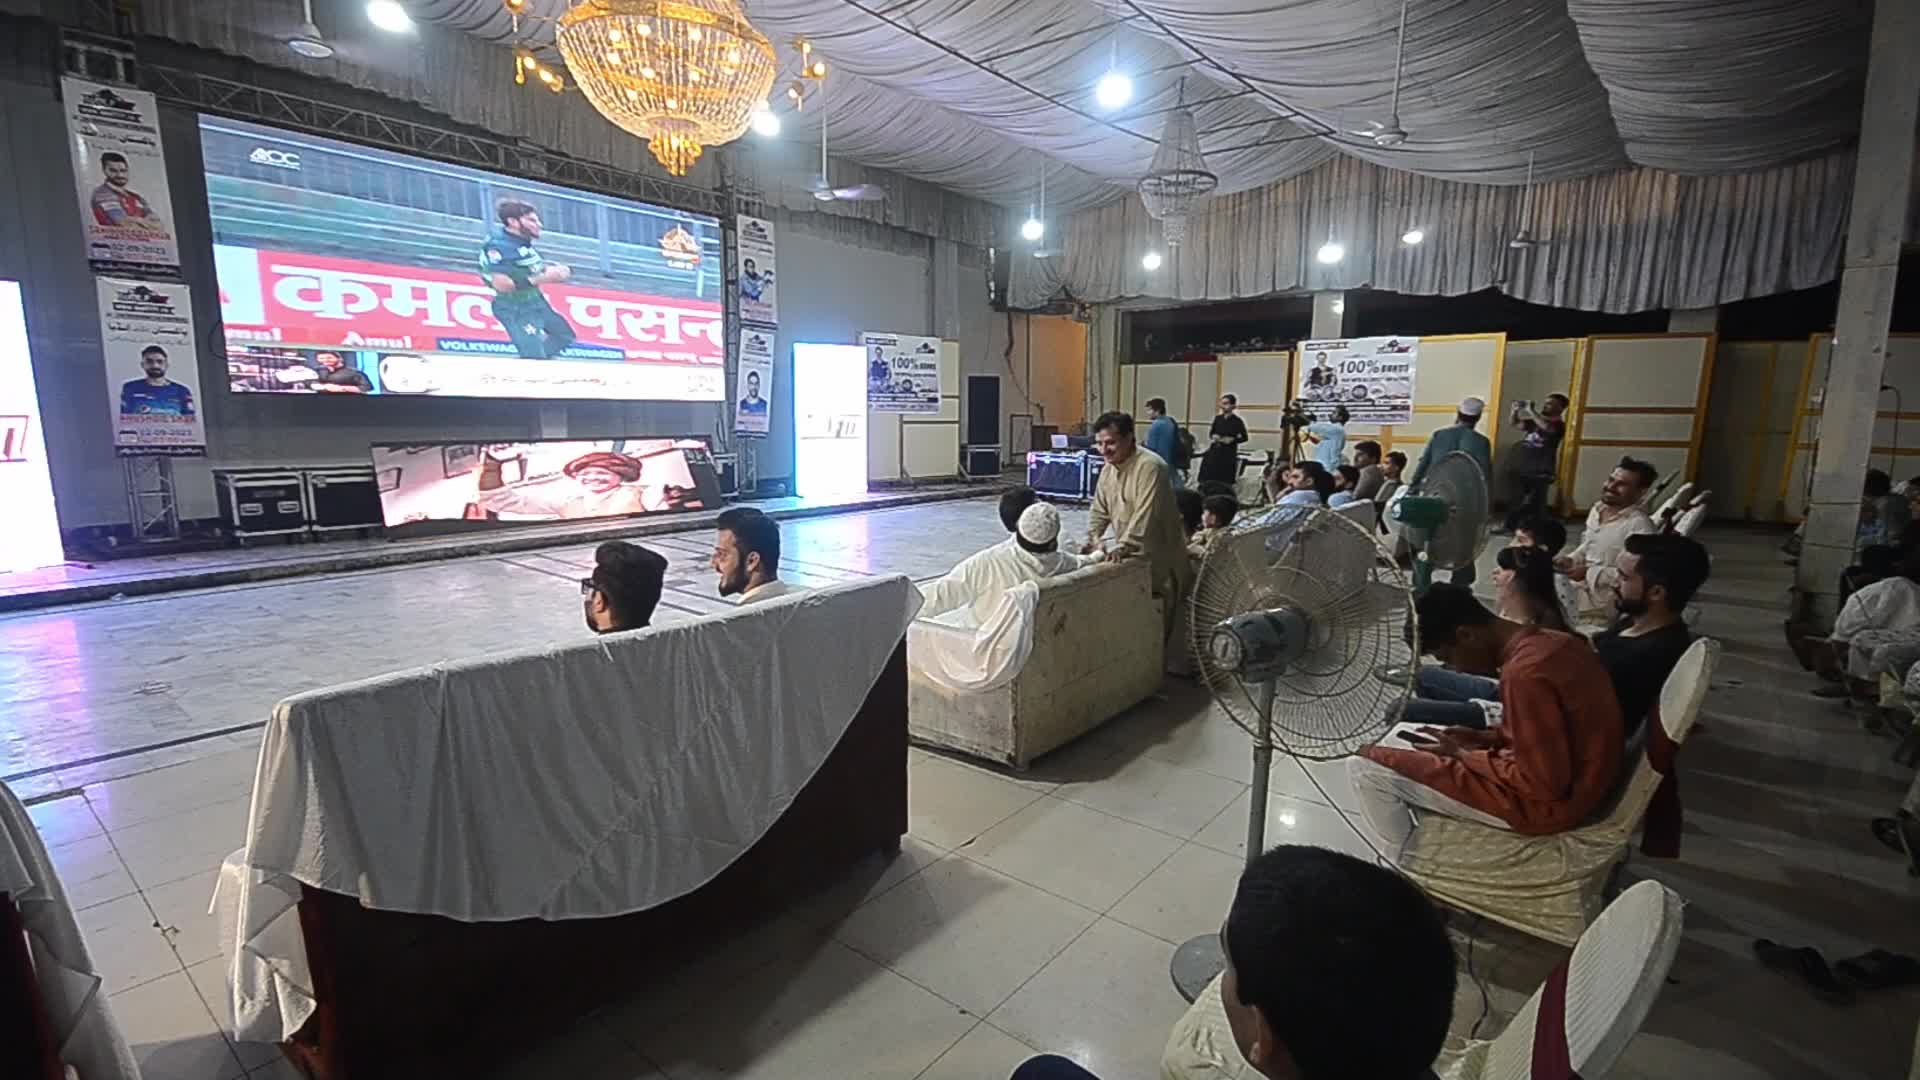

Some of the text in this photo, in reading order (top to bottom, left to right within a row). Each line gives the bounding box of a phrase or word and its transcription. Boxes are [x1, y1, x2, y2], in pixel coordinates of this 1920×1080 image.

[225, 327, 282, 342] mul
[341, 331, 412, 348] Amul
[1338, 359, 1380, 374] 100%
